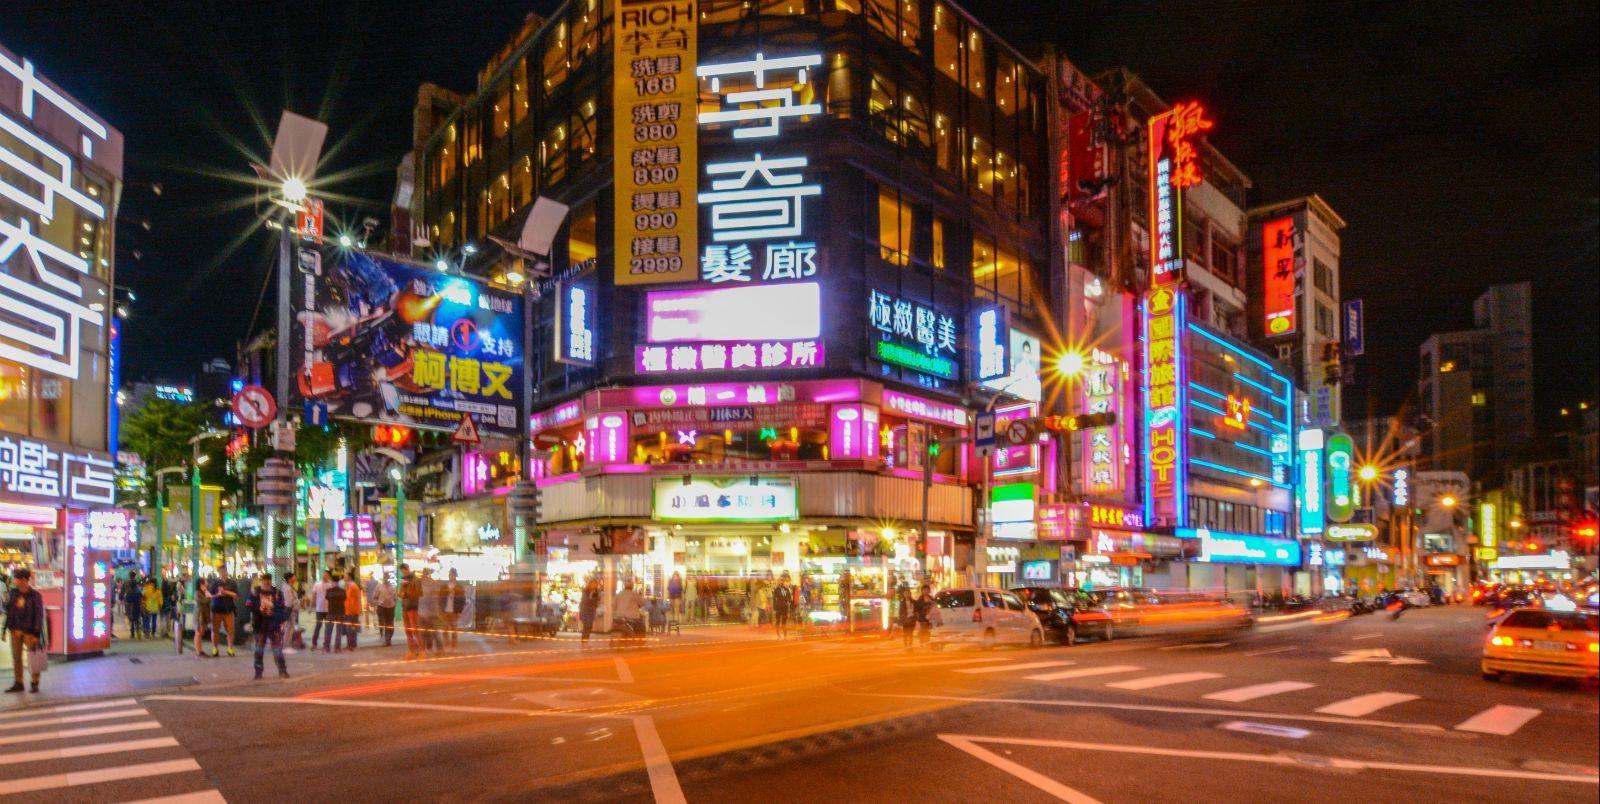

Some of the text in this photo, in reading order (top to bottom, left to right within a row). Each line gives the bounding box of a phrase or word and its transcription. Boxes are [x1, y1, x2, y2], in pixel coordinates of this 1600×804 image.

[621, 4, 692, 28] RICH
[631, 54, 681, 77] 洗髮
[634, 77, 677, 96] 168
[632, 102, 681, 124] 洗剪
[634, 123, 677, 142] 380
[631, 146, 681, 167] 染髮
[633, 166, 677, 185] 890
[635, 212, 677, 231] 990
[632, 235, 681, 256] 接髮
[630, 256, 683, 274] 2999
[701, 241, 816, 283] 髮廊
[869, 288, 956, 354] 極緻醫美
[479, 330, 514, 358] 支持
[412, 349, 513, 400] 柯博文
